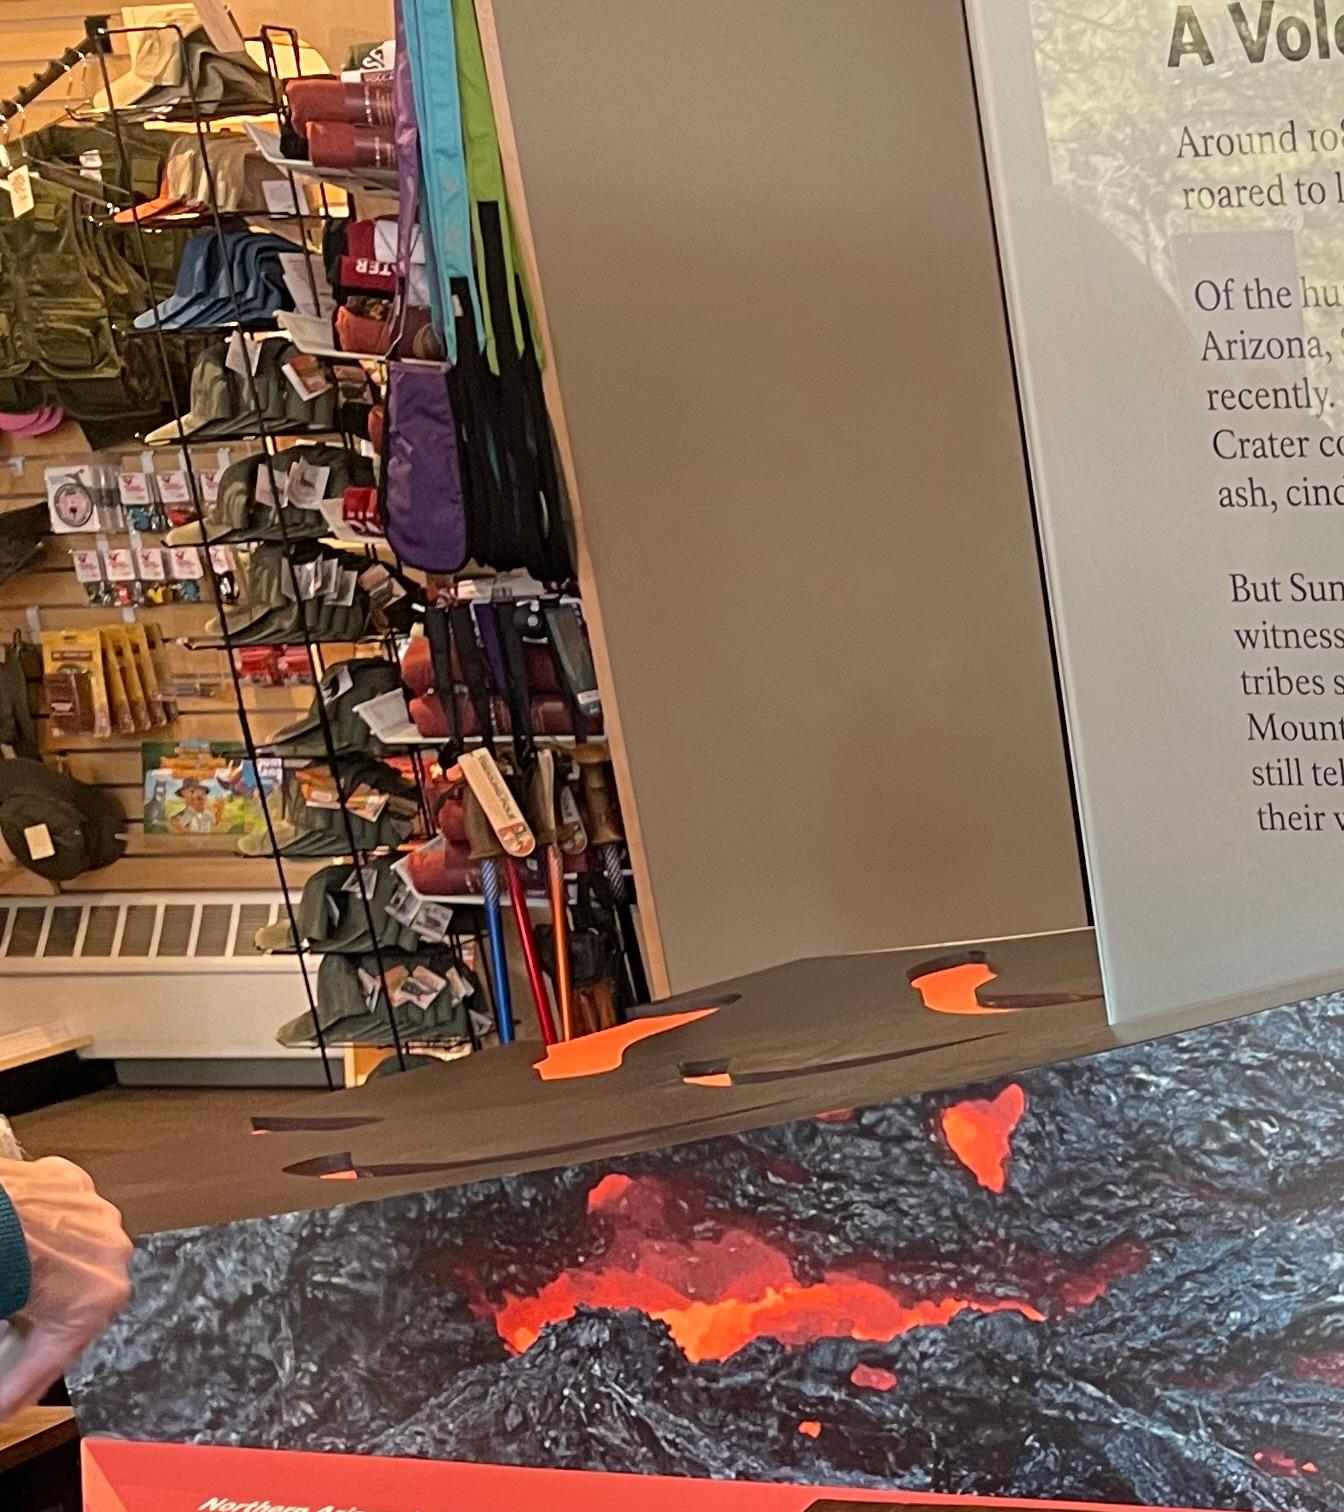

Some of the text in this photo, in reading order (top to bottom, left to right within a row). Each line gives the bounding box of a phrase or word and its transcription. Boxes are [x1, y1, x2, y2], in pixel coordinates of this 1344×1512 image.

[1167, 5, 1214, 67] A
[1177, 120, 1297, 158] Around
[1183, 173, 1286, 209] roared
[1294, 178, 1325, 205] to
[1195, 278, 1234, 312] Of
[1244, 278, 1292, 309] the
[1202, 330, 1332, 364] Arizona,
[1229, 574, 1282, 602] But
[1241, 667, 1324, 695] tribes
